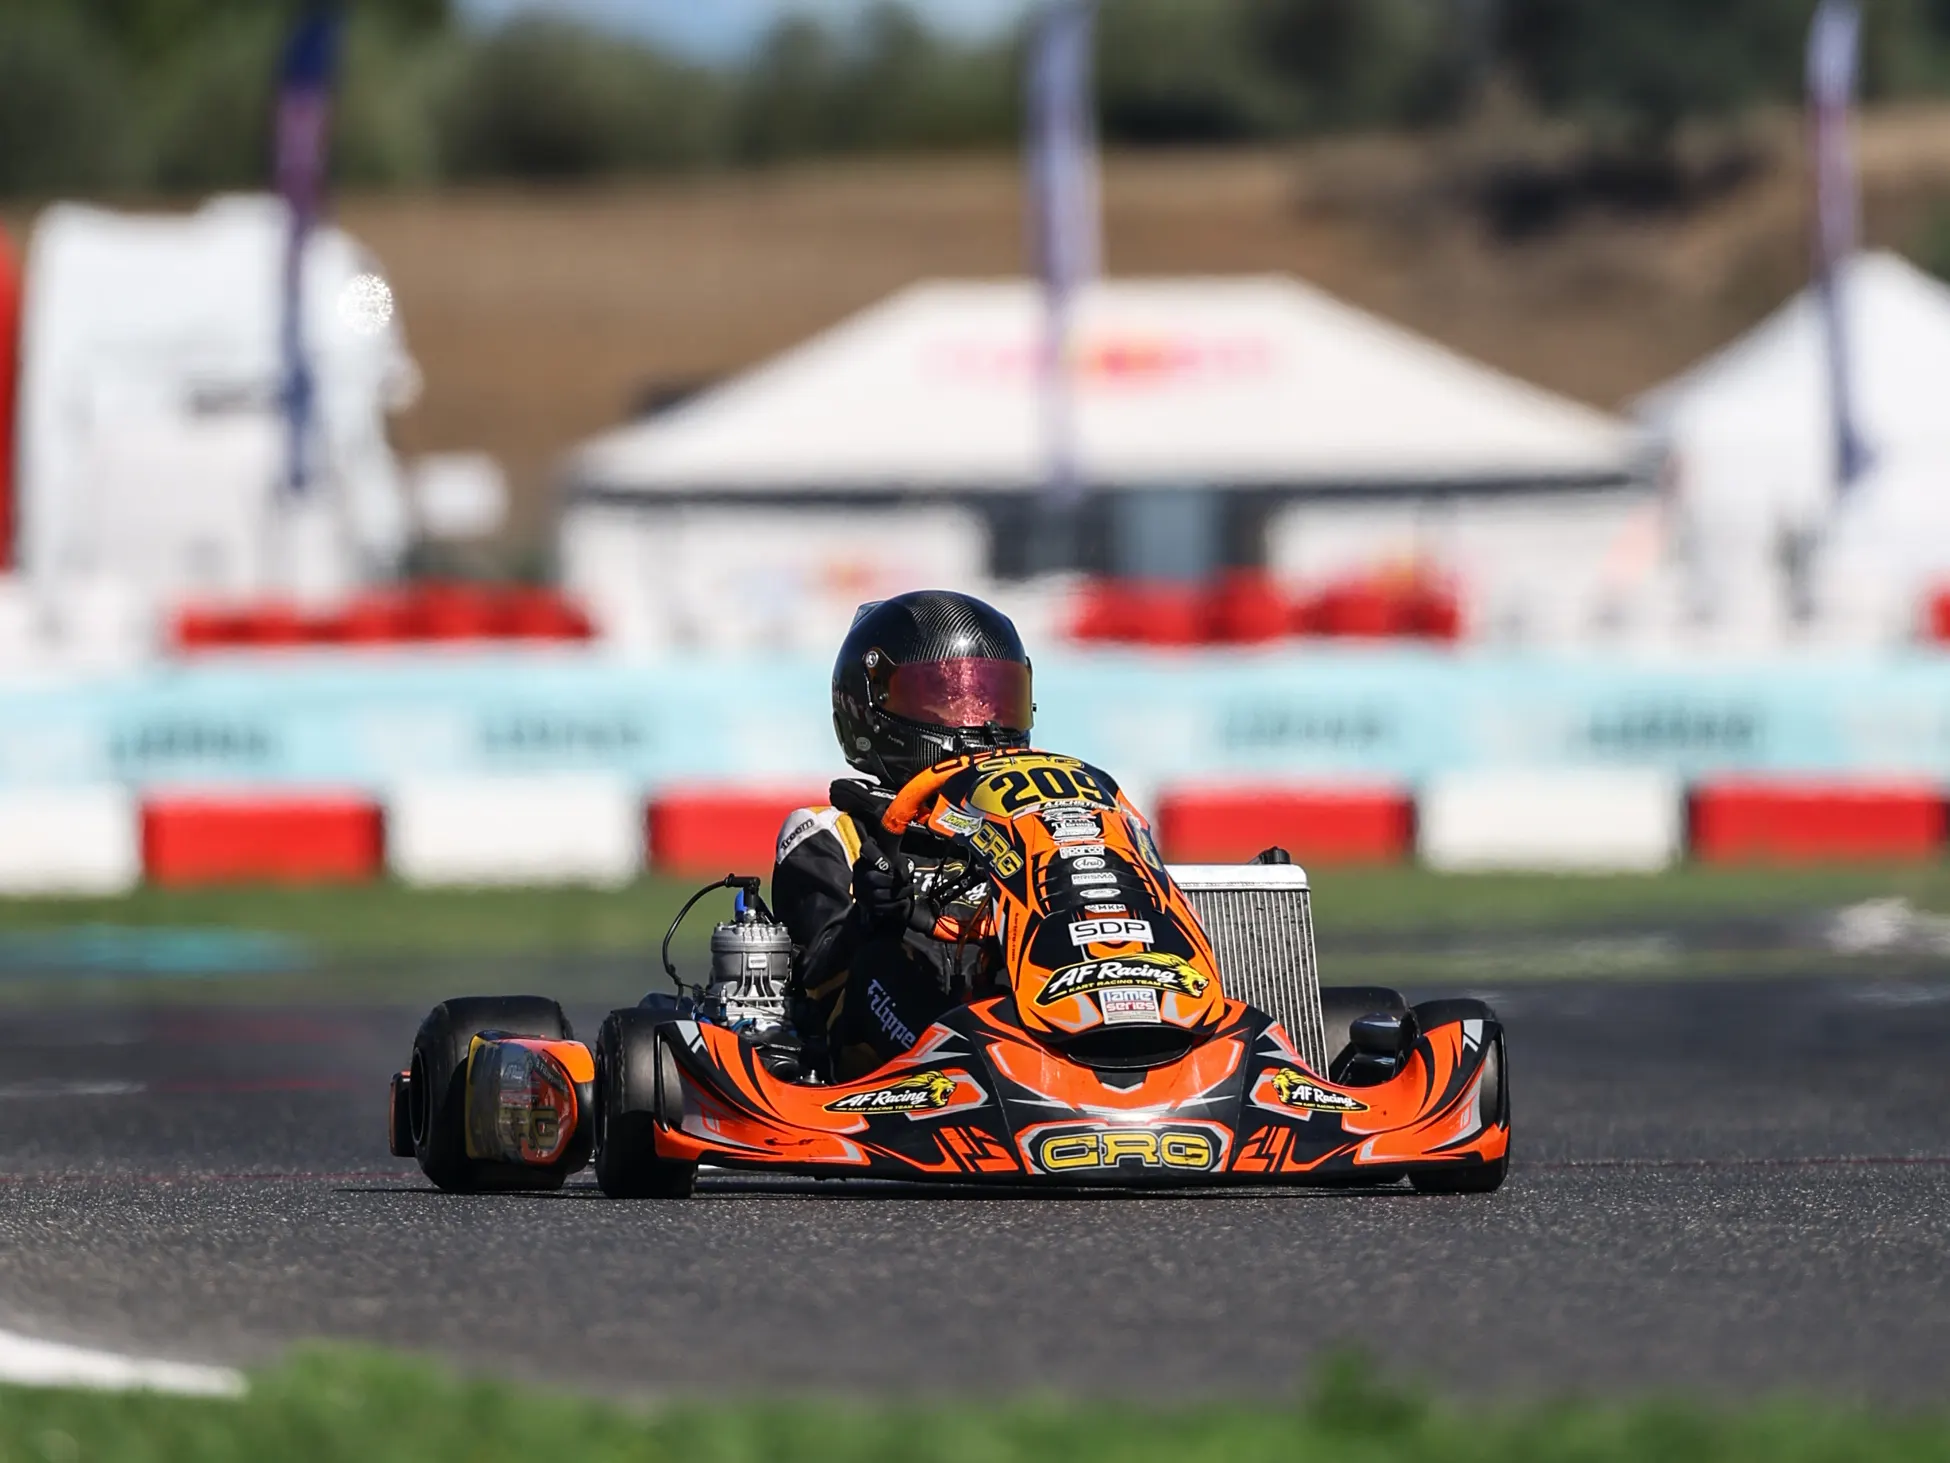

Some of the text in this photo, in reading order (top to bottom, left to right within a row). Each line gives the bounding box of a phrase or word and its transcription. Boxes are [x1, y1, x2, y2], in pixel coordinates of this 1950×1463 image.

[989, 766, 1104, 814] 209
[970, 822, 1024, 879] CRG
[1072, 873, 1114, 881] PRISMA
[1074, 921, 1146, 938] SDP
[1048, 962, 1177, 993] AF Racing
[1069, 983, 1094, 992] KART
[1097, 979, 1133, 987] RACING
[1106, 1001, 1155, 1011] series
[836, 1090, 929, 1107] AF Racing
[1292, 1085, 1356, 1107] AF Racing
[1041, 1130, 1213, 1172] CRG
